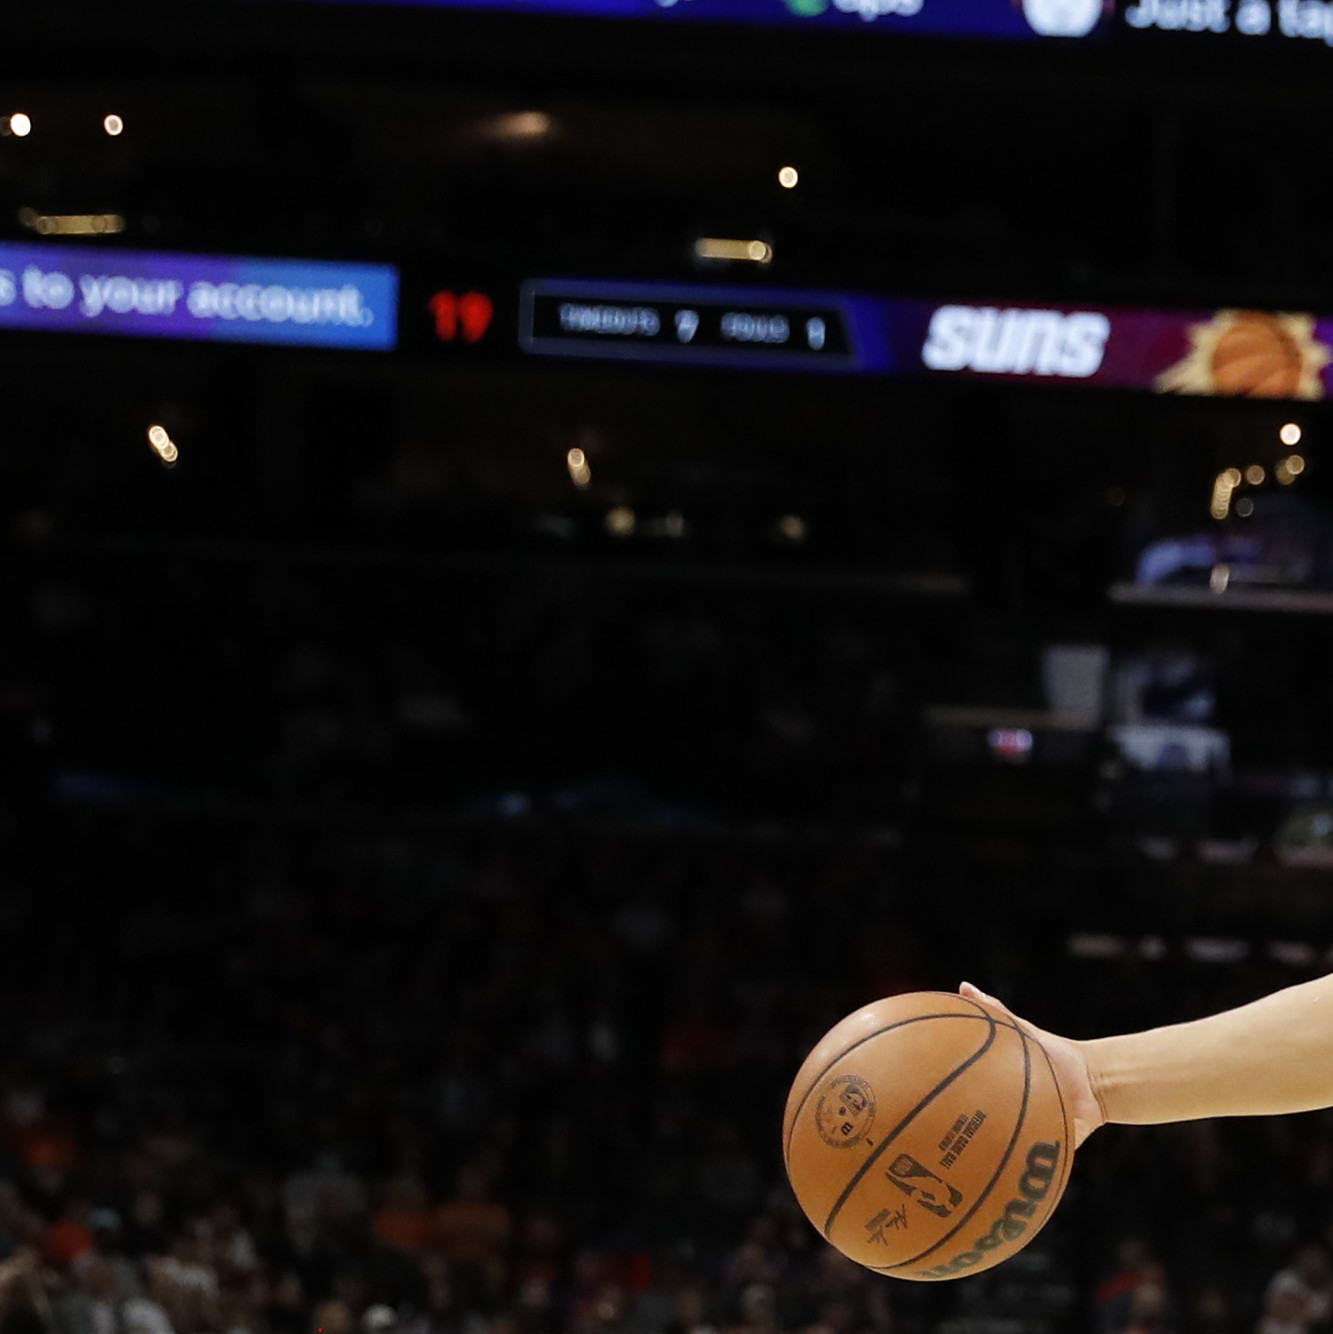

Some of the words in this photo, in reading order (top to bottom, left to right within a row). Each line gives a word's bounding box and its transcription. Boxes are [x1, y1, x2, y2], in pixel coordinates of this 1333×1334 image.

[22, 263, 75, 310] to
[79, 273, 184, 318] your
[186, 280, 374, 328] account.
